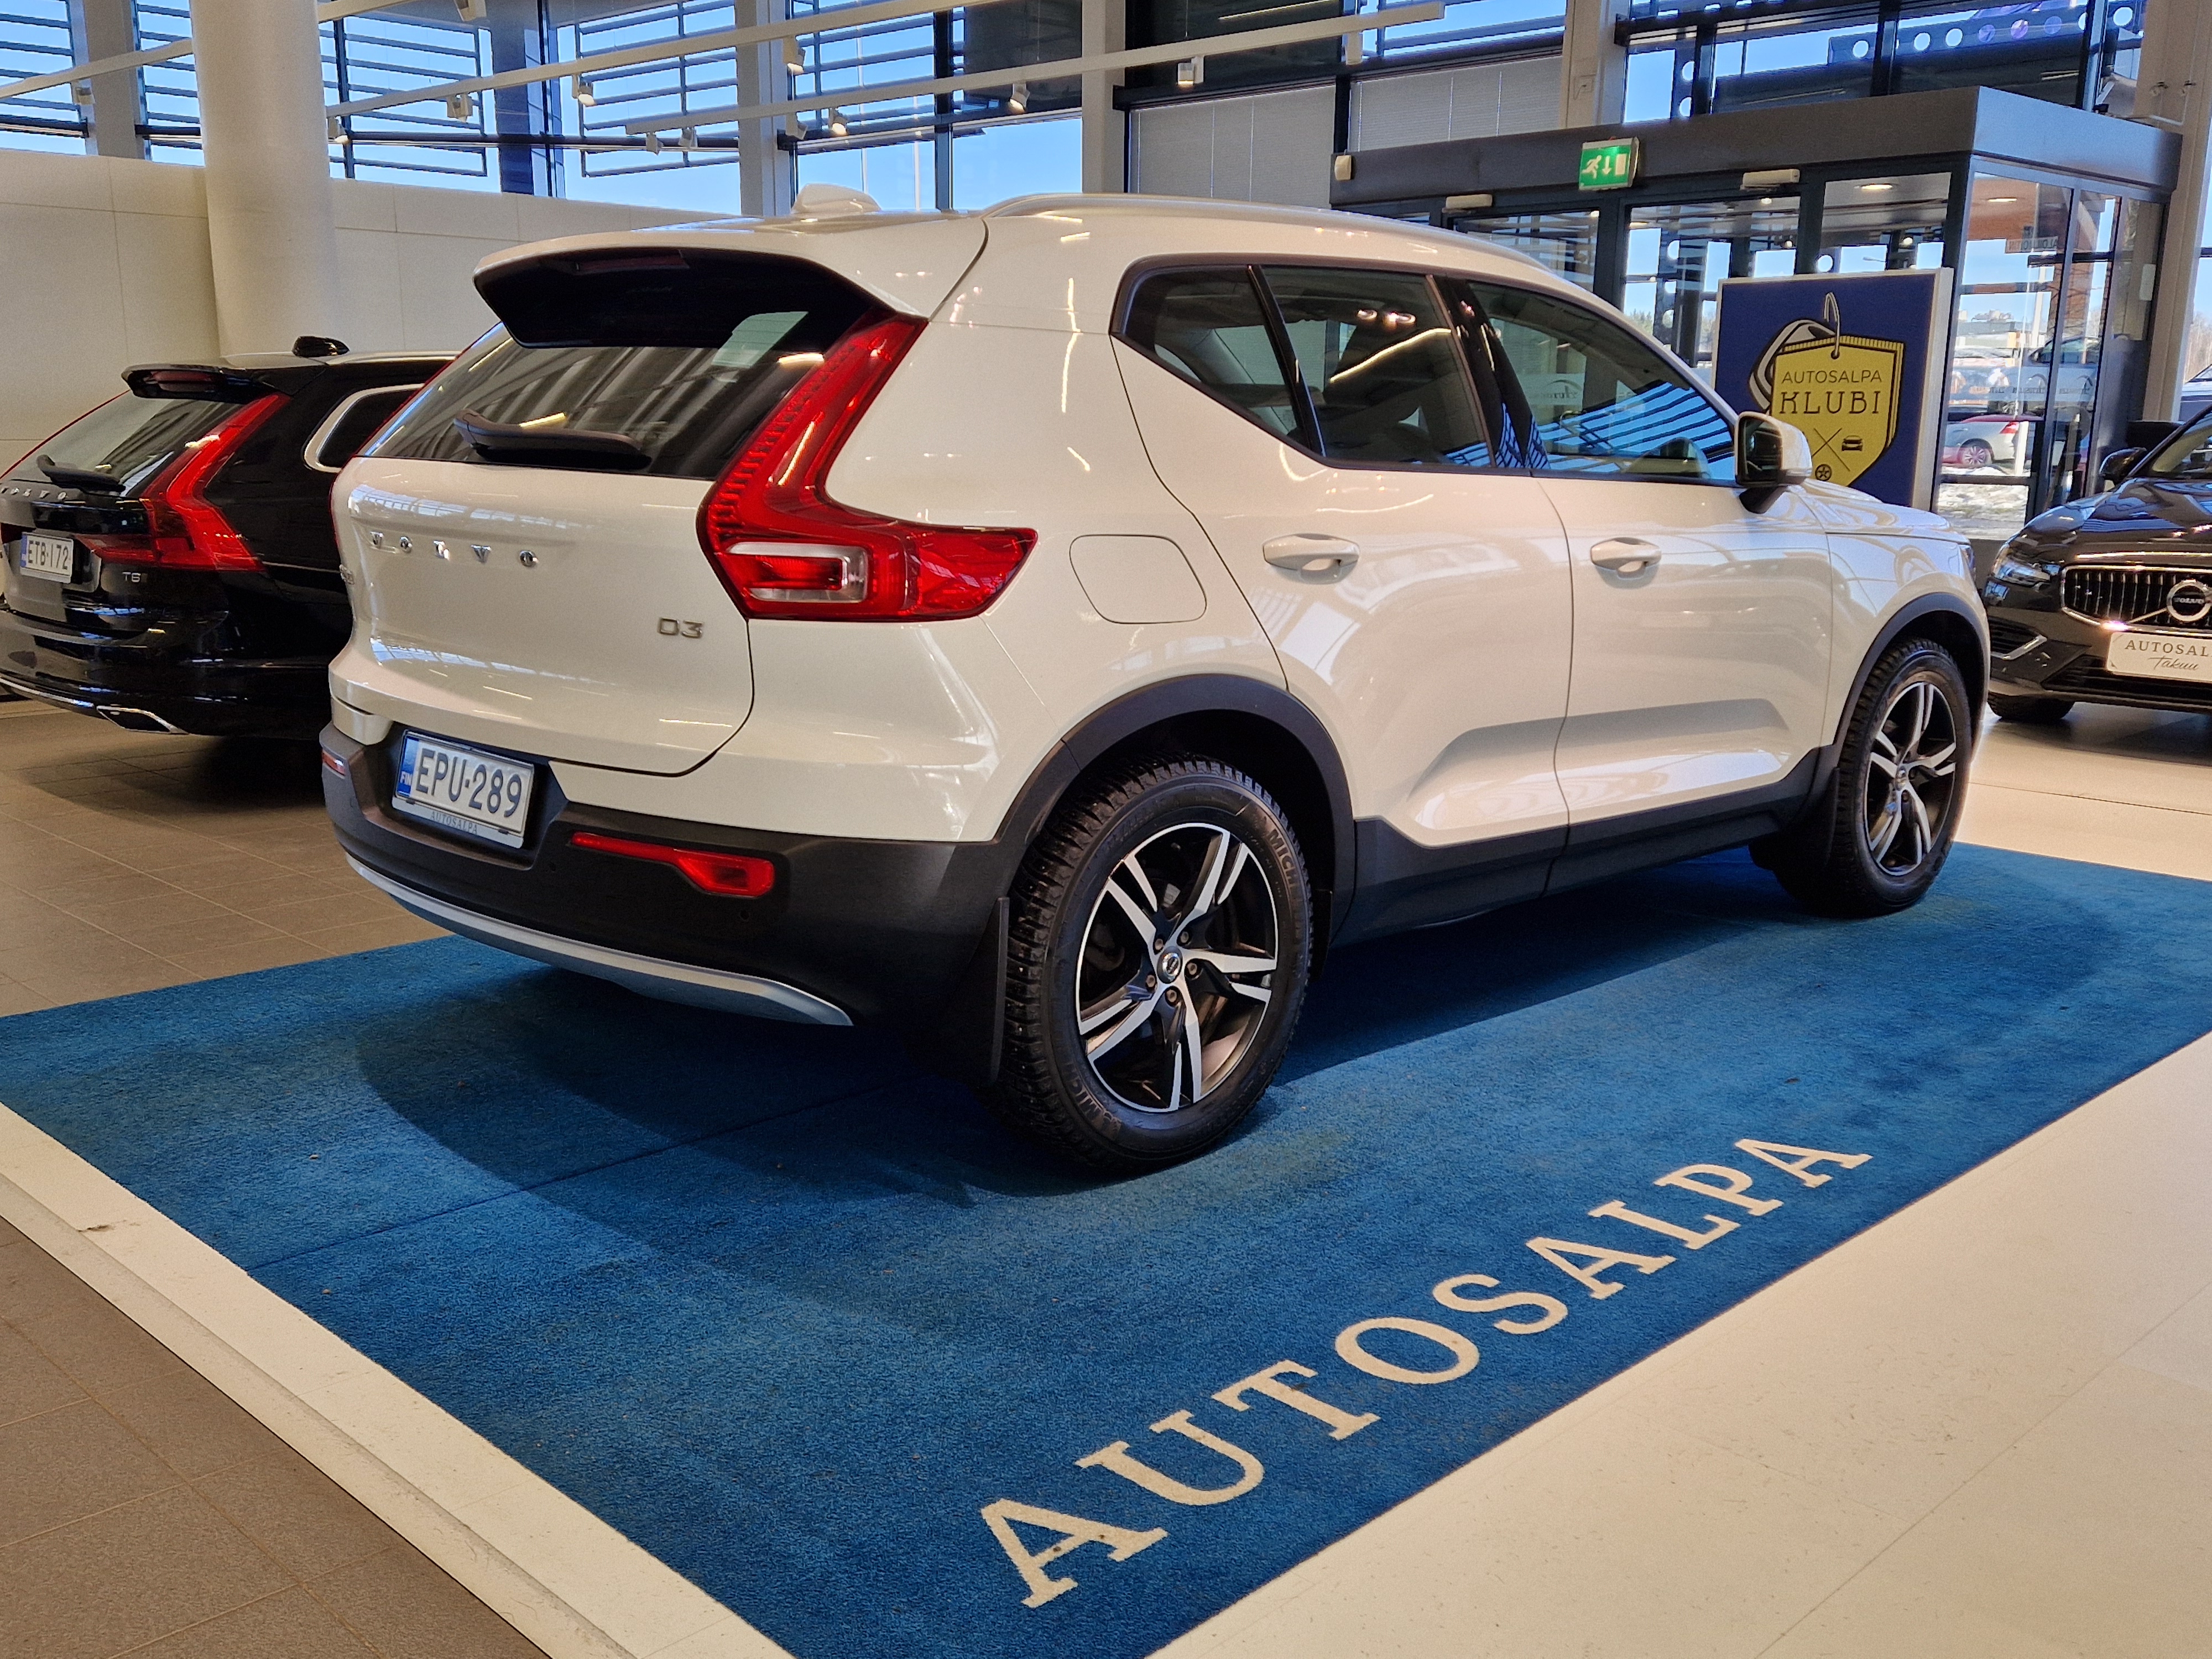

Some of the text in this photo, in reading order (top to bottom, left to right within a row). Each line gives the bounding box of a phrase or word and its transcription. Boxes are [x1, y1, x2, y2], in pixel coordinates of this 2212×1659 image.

[1782, 370, 1882, 384] AUTOSALPA
[1780, 390, 1881, 414] KLUBI
[28, 540, 69, 570] ETB-172
[370, 531, 539, 567] VOLVO
[122, 572, 141, 583] T6
[658, 617, 703, 639] D3
[2125, 640, 2212, 657] AUTOSAL
[2148, 656, 2199, 671] Takuu
[416, 748, 522, 817] EPU-289
[430, 811, 478, 834] AUTOSALPA
[980, 1137, 1872, 1609] AUTOSALPA
